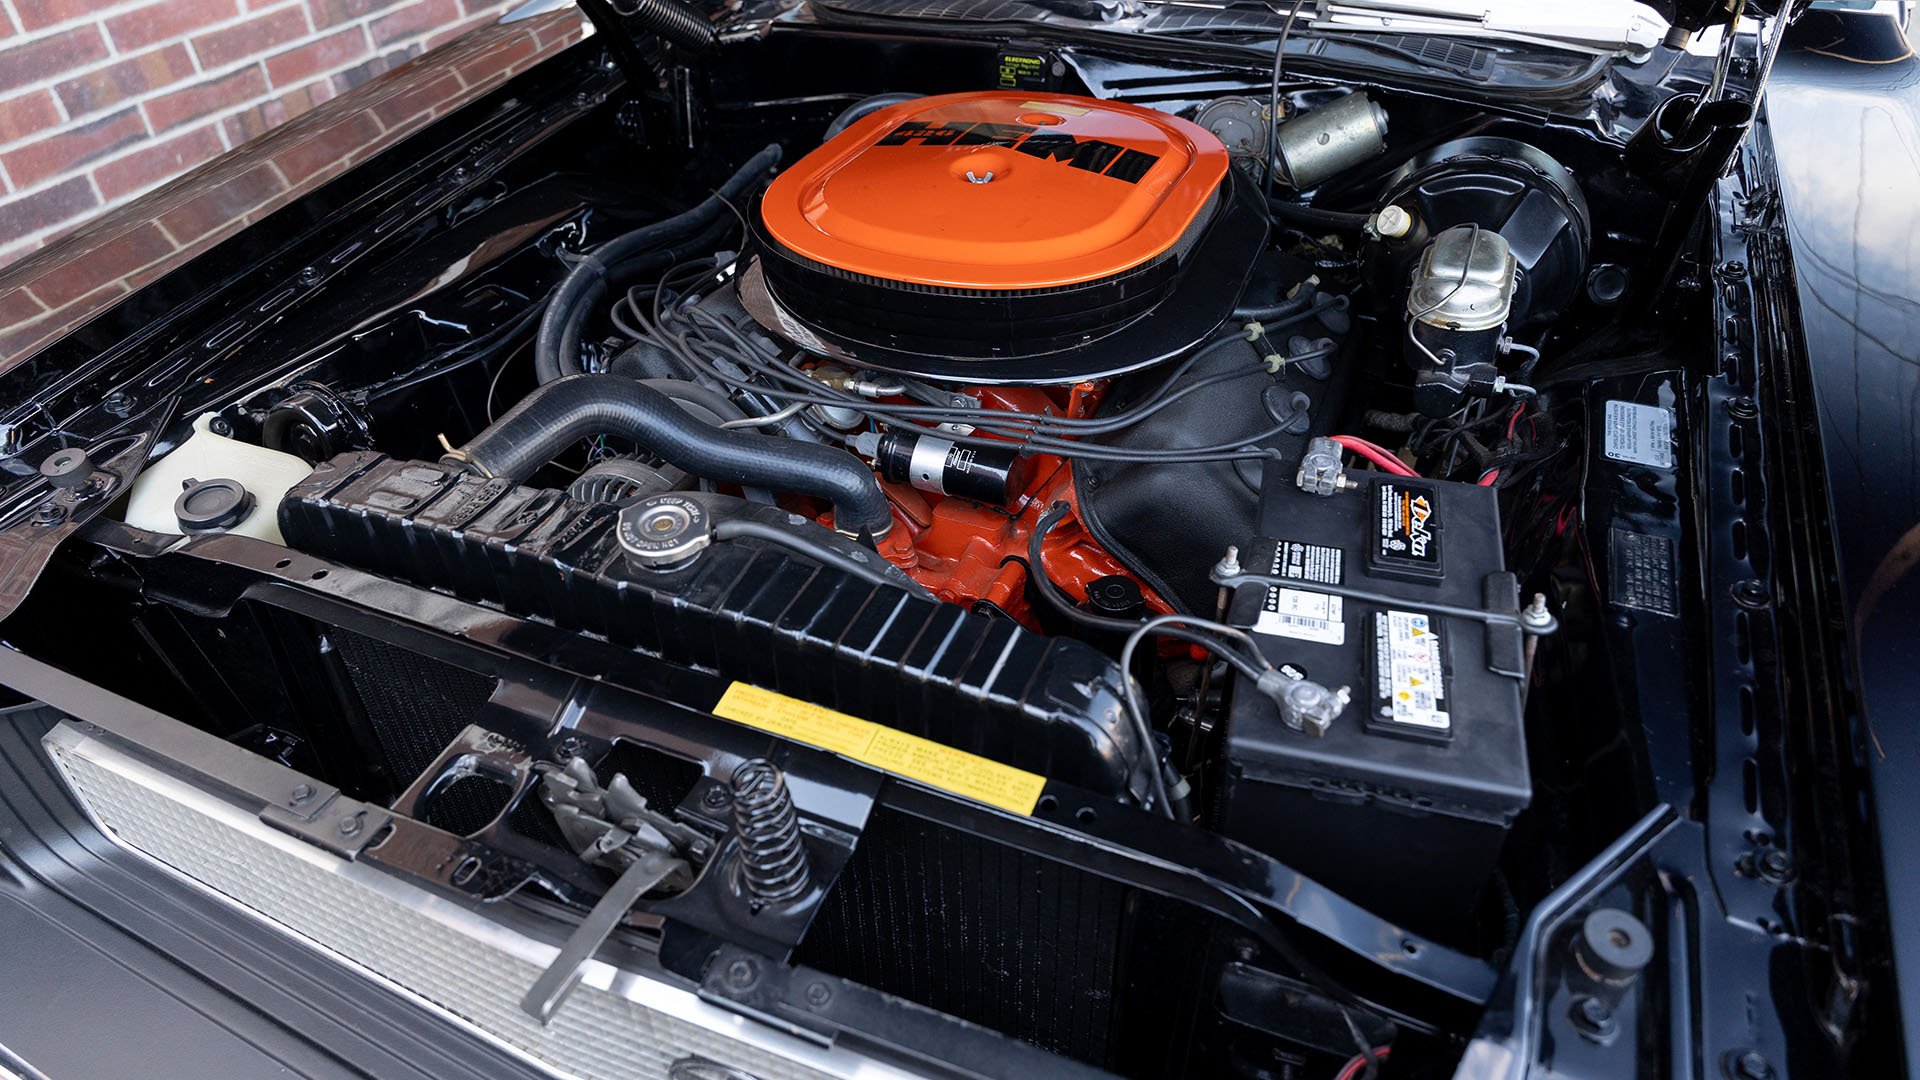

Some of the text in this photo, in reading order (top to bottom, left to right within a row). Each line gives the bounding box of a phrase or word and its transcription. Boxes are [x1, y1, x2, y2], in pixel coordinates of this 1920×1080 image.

[1004, 55, 1041, 65] ELECTRONIC
[874, 121, 1160, 185] HEMI
[1410, 495, 1432, 557] Deka
